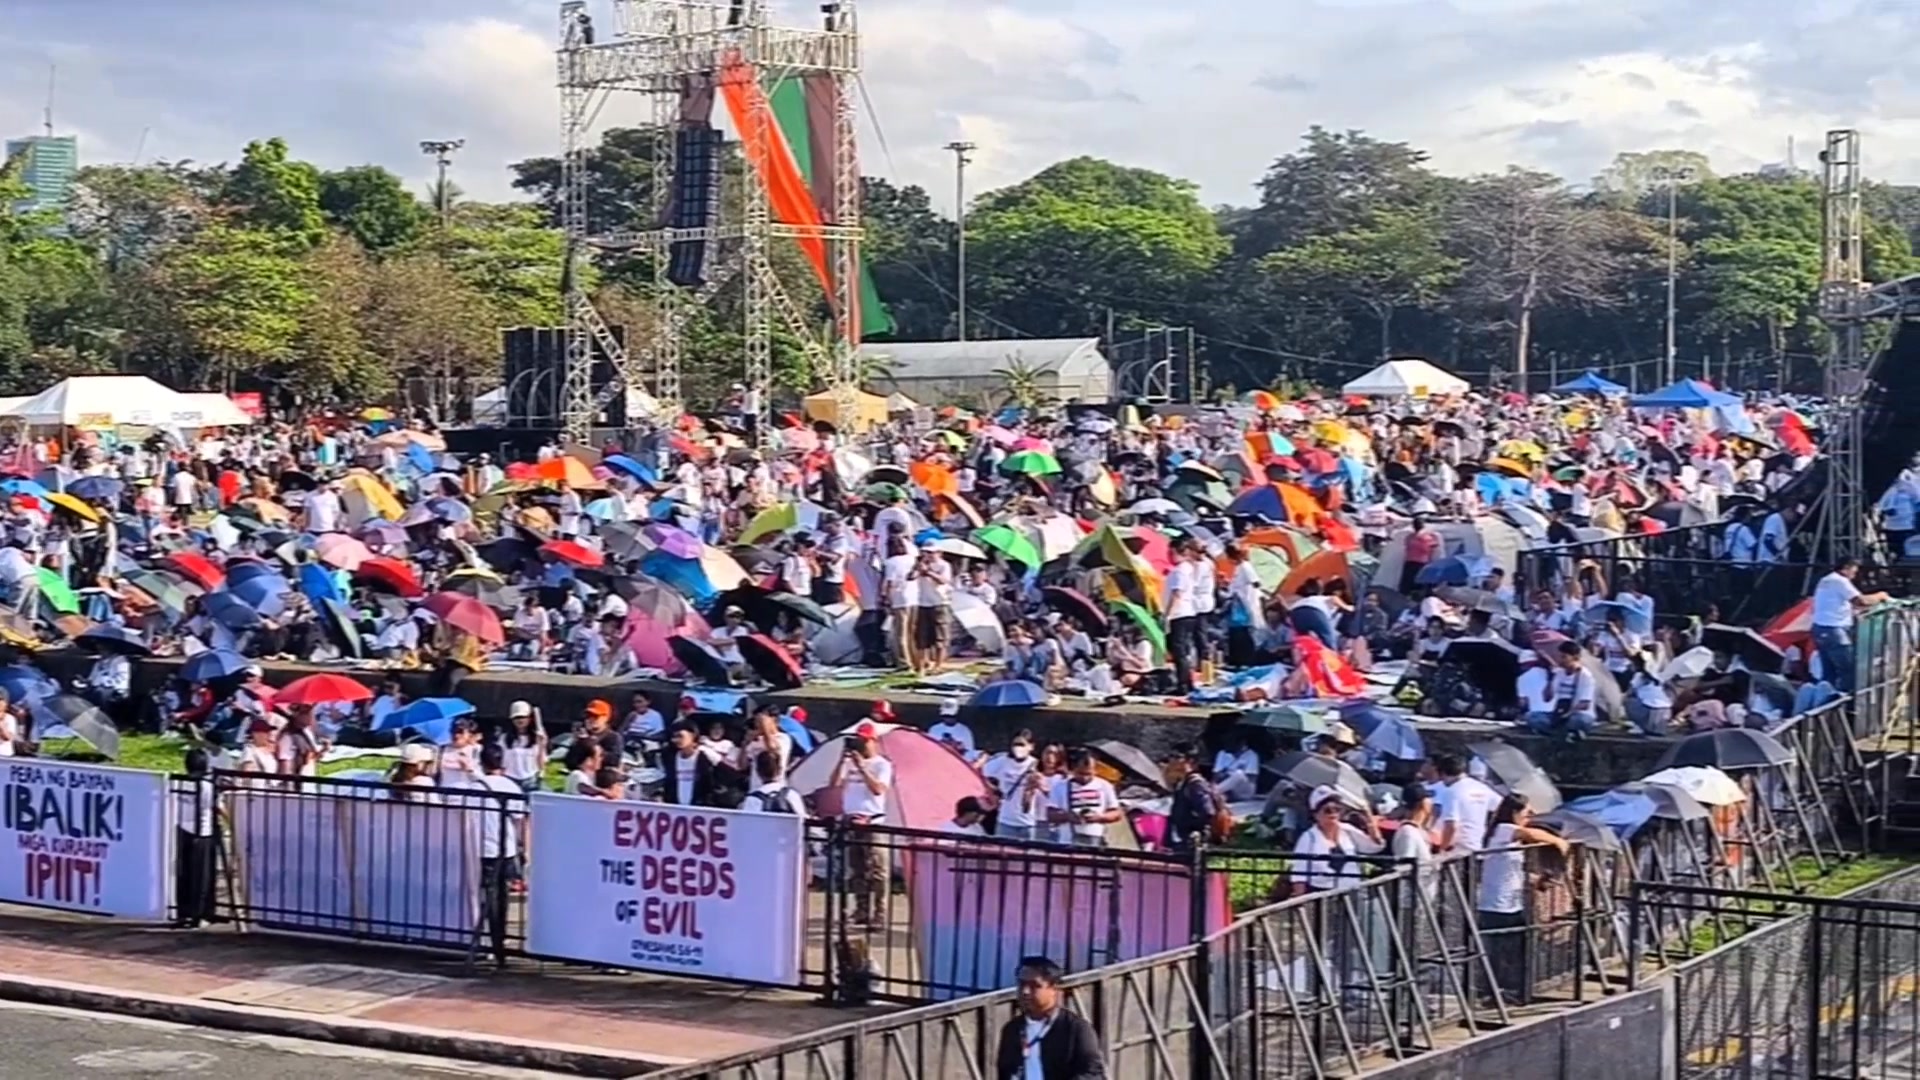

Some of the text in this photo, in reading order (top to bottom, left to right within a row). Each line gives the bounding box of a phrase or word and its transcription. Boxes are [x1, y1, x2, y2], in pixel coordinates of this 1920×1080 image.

[10, 765, 115, 791] PERA NG BAYAN
[4, 783, 124, 842] IBALIK!
[614, 809, 729, 859] EXPOSE
[18, 833, 48, 852] MGA
[26, 852, 101, 907] IPIIT!
[600, 854, 735, 900] THE DEEDS
[615, 896, 703, 940] OF EVIL
